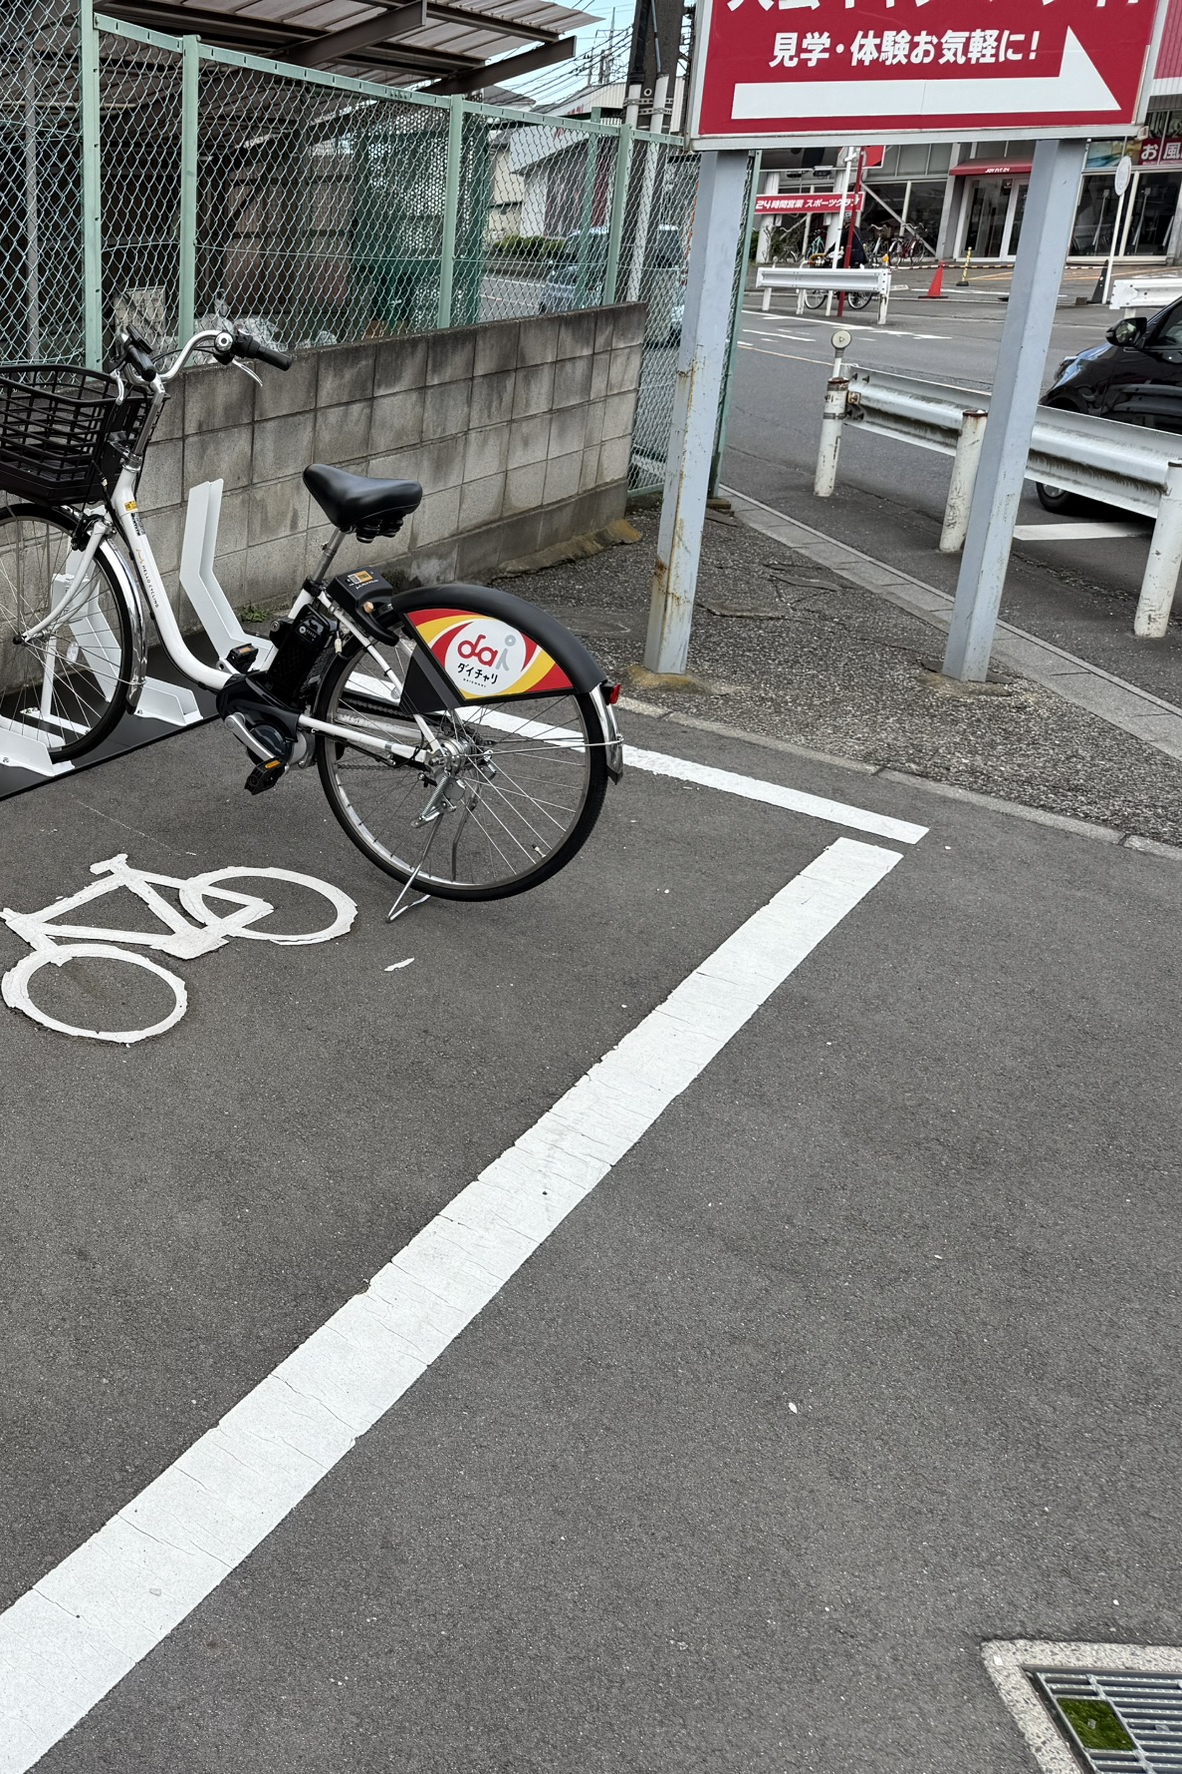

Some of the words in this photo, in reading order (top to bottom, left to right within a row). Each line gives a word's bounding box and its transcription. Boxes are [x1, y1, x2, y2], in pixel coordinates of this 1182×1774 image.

[769, 29, 1040, 68] 見学・体験お気軽に!
[1141, 142, 1182, 160] お風
[755, 199, 804, 210] 24時間営業
[458, 634, 517, 672] dai
[458, 662, 498, 685] ダイチャリ
